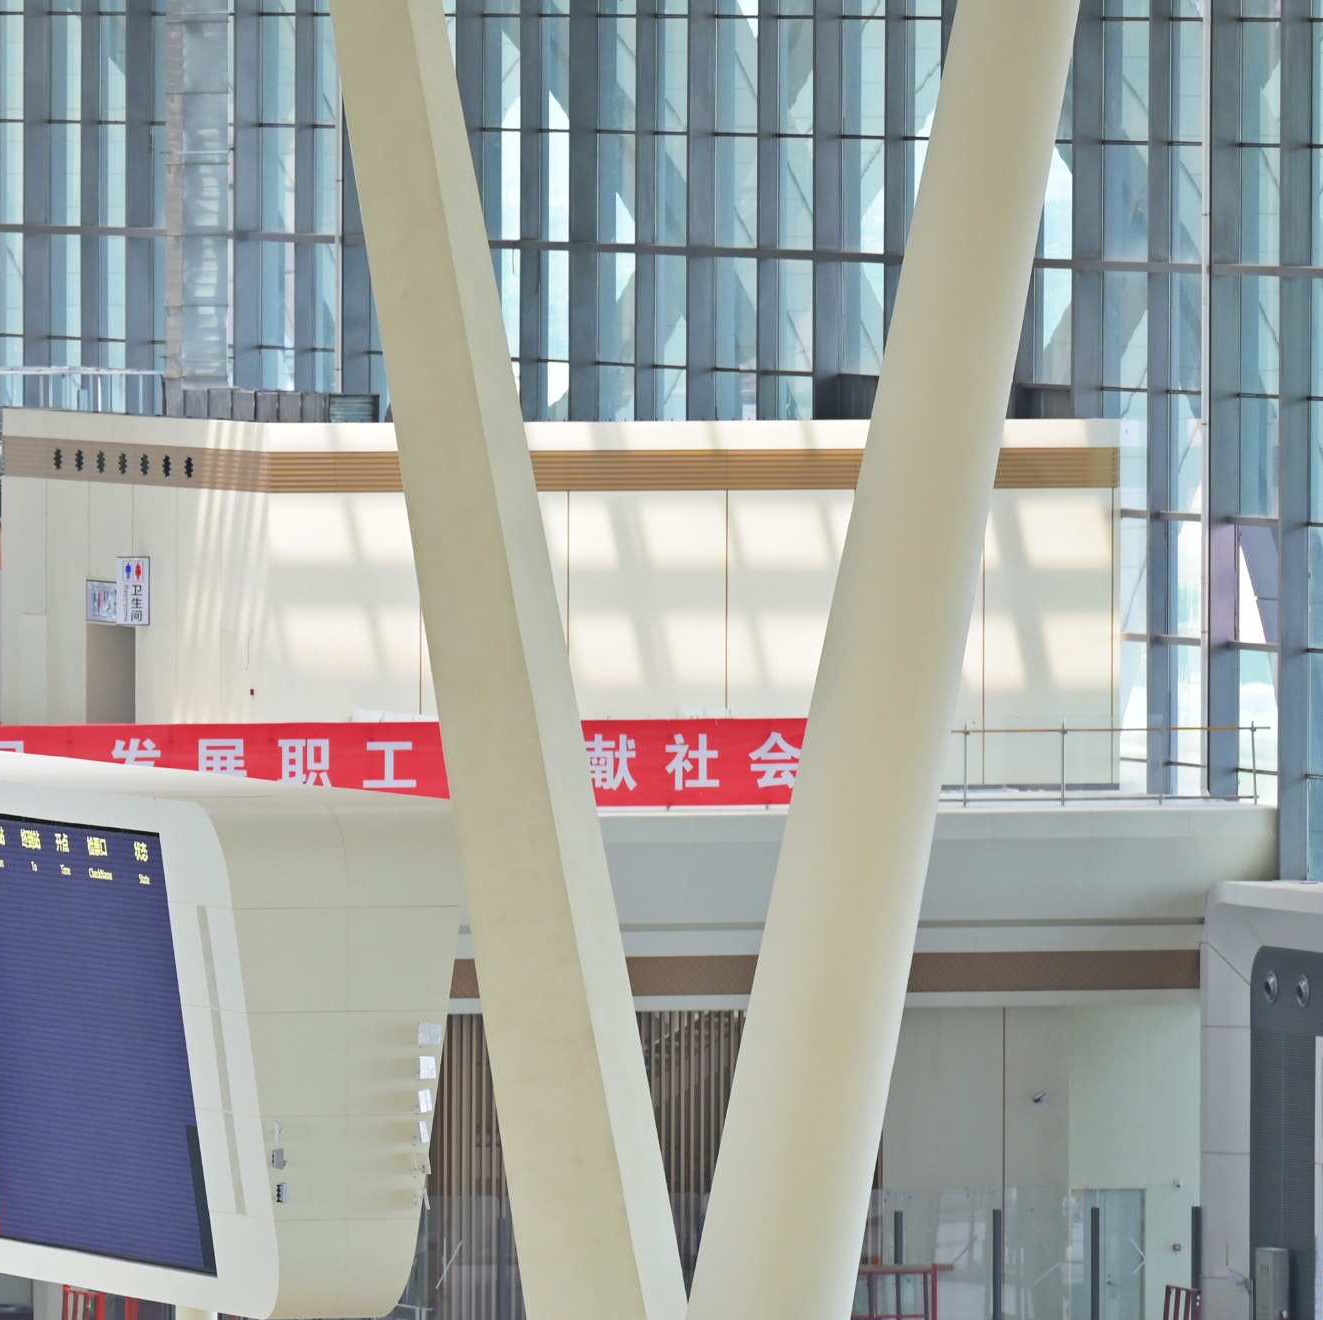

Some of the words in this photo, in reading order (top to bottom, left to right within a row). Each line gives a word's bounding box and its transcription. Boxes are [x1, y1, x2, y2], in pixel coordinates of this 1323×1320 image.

[131, 585, 143, 622] 卫生间
[54, 832, 70, 853] 开点
